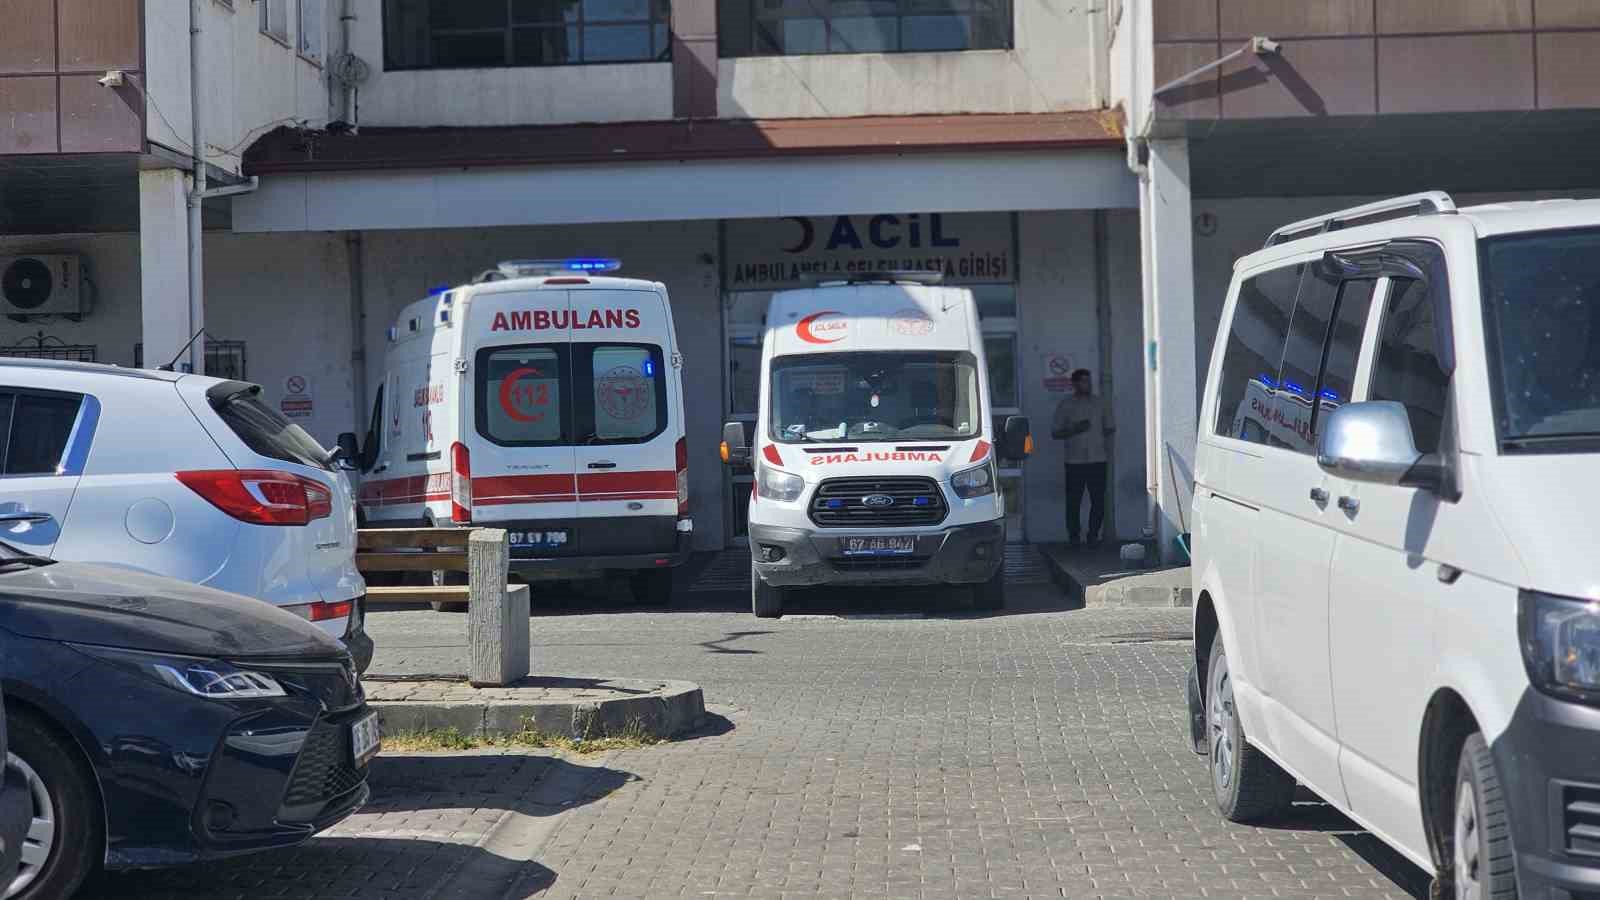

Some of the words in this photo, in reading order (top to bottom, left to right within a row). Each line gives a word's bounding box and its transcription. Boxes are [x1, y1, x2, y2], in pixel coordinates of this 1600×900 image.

[959, 251, 1008, 278] GİRİŞİ
[491, 309, 641, 332] AMBULANS
[512, 383, 550, 408] 112
[509, 532, 523, 544] 67
[849, 539, 864, 551] 67
